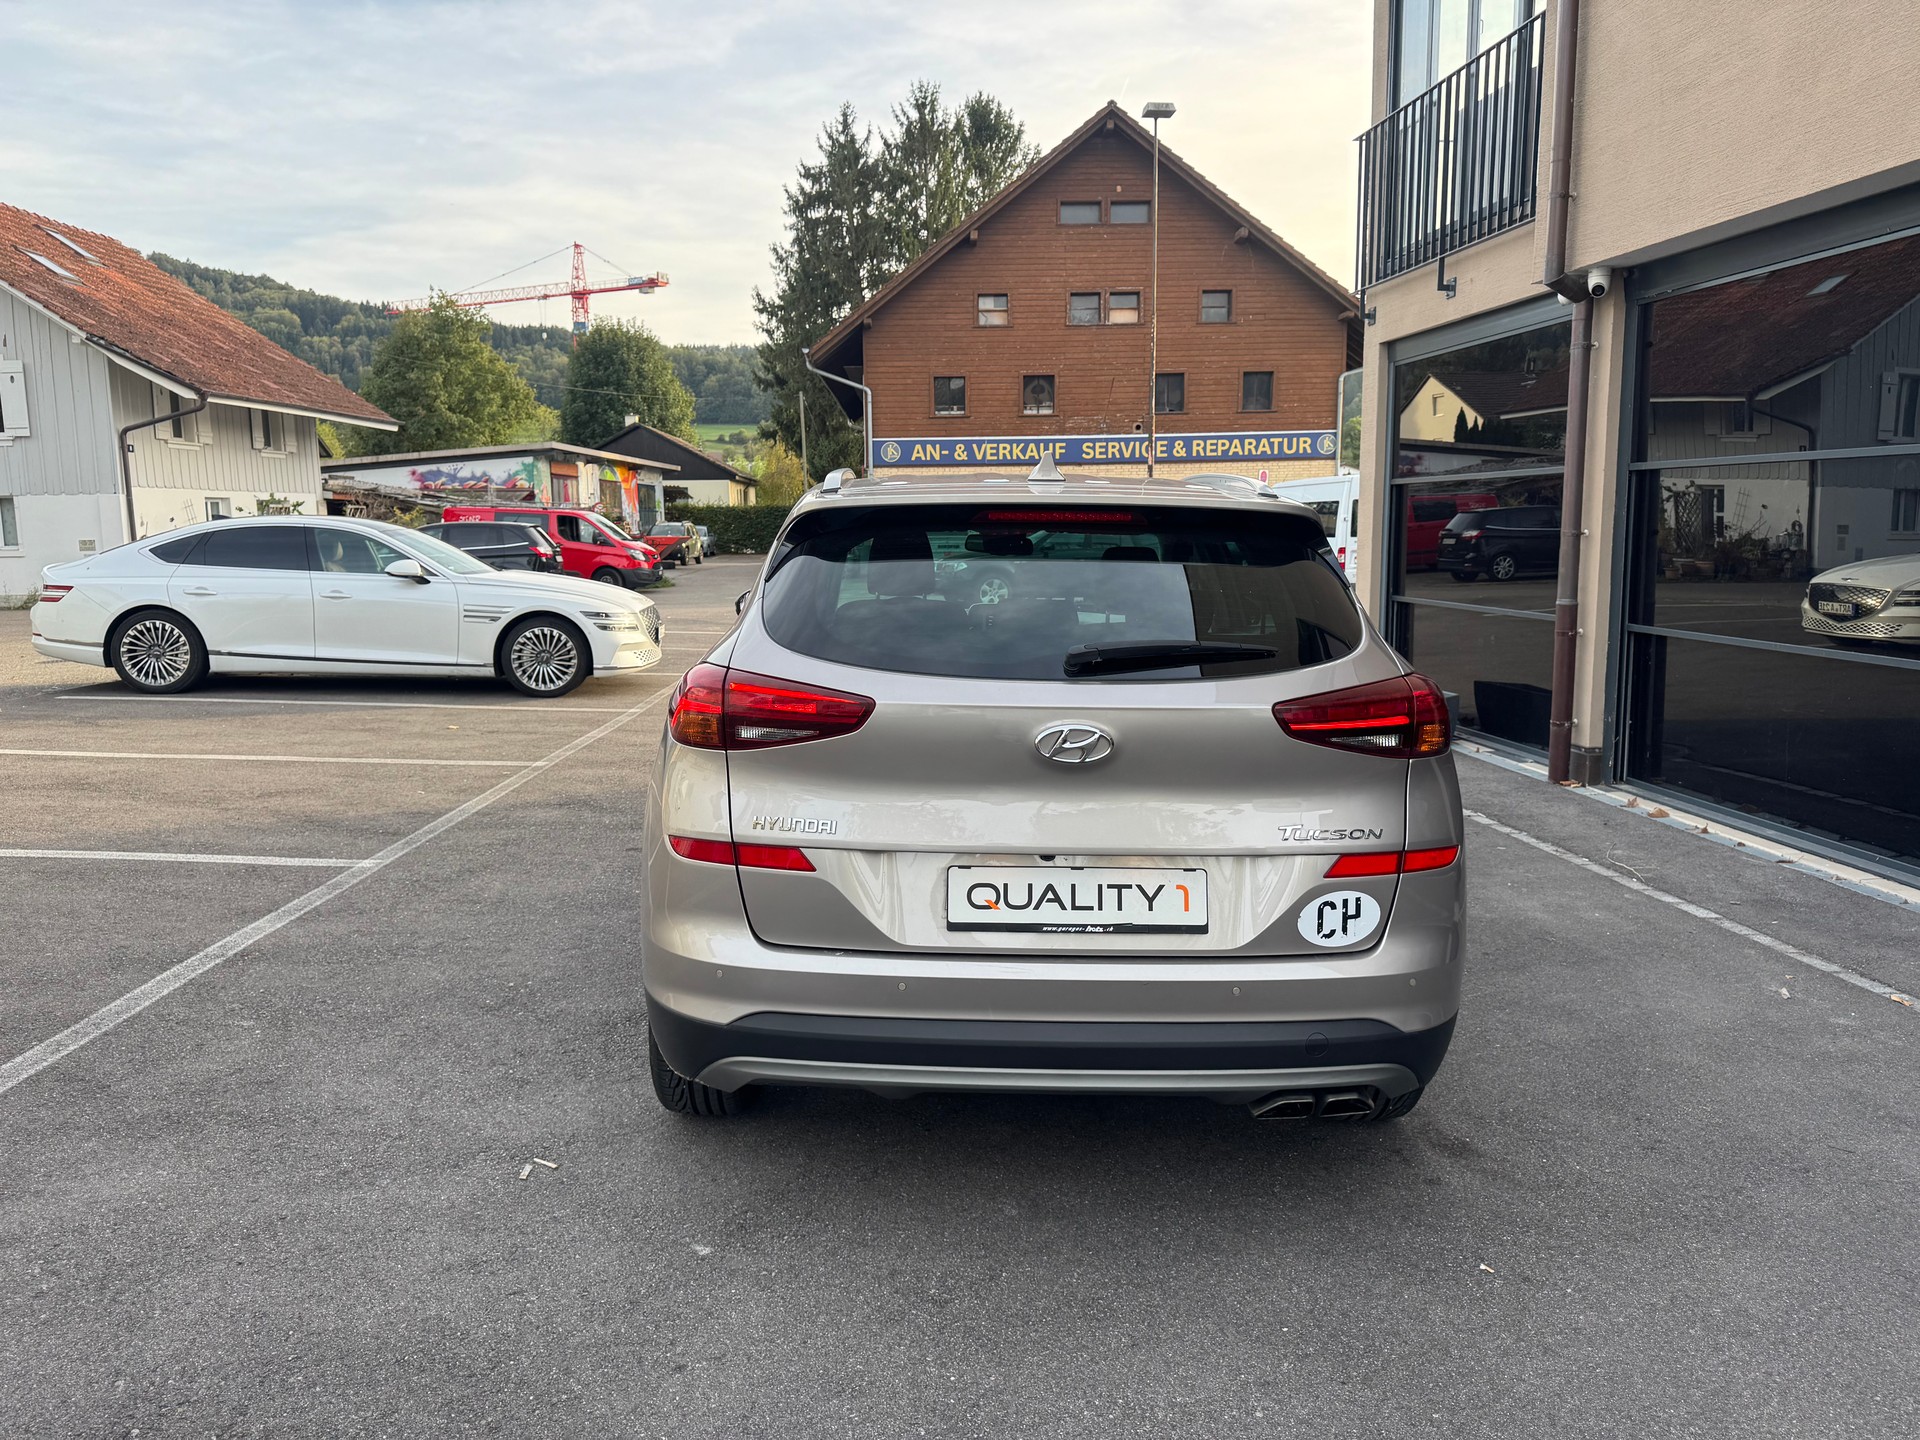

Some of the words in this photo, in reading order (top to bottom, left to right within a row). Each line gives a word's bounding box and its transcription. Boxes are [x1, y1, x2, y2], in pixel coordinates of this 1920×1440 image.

[911, 444, 949, 460] AN-
[954, 443, 968, 460] &
[972, 442, 1066, 460] VERKAUF
[1082, 441, 1168, 459] SERVICE
[1173, 440, 1187, 457] &
[1192, 437, 1312, 456] REPARATUR
[752, 815, 837, 834] HYUNDAI
[1278, 824, 1383, 841] TUCSON
[966, 882, 1166, 912] QUALITY
[1317, 896, 1362, 939] CH
